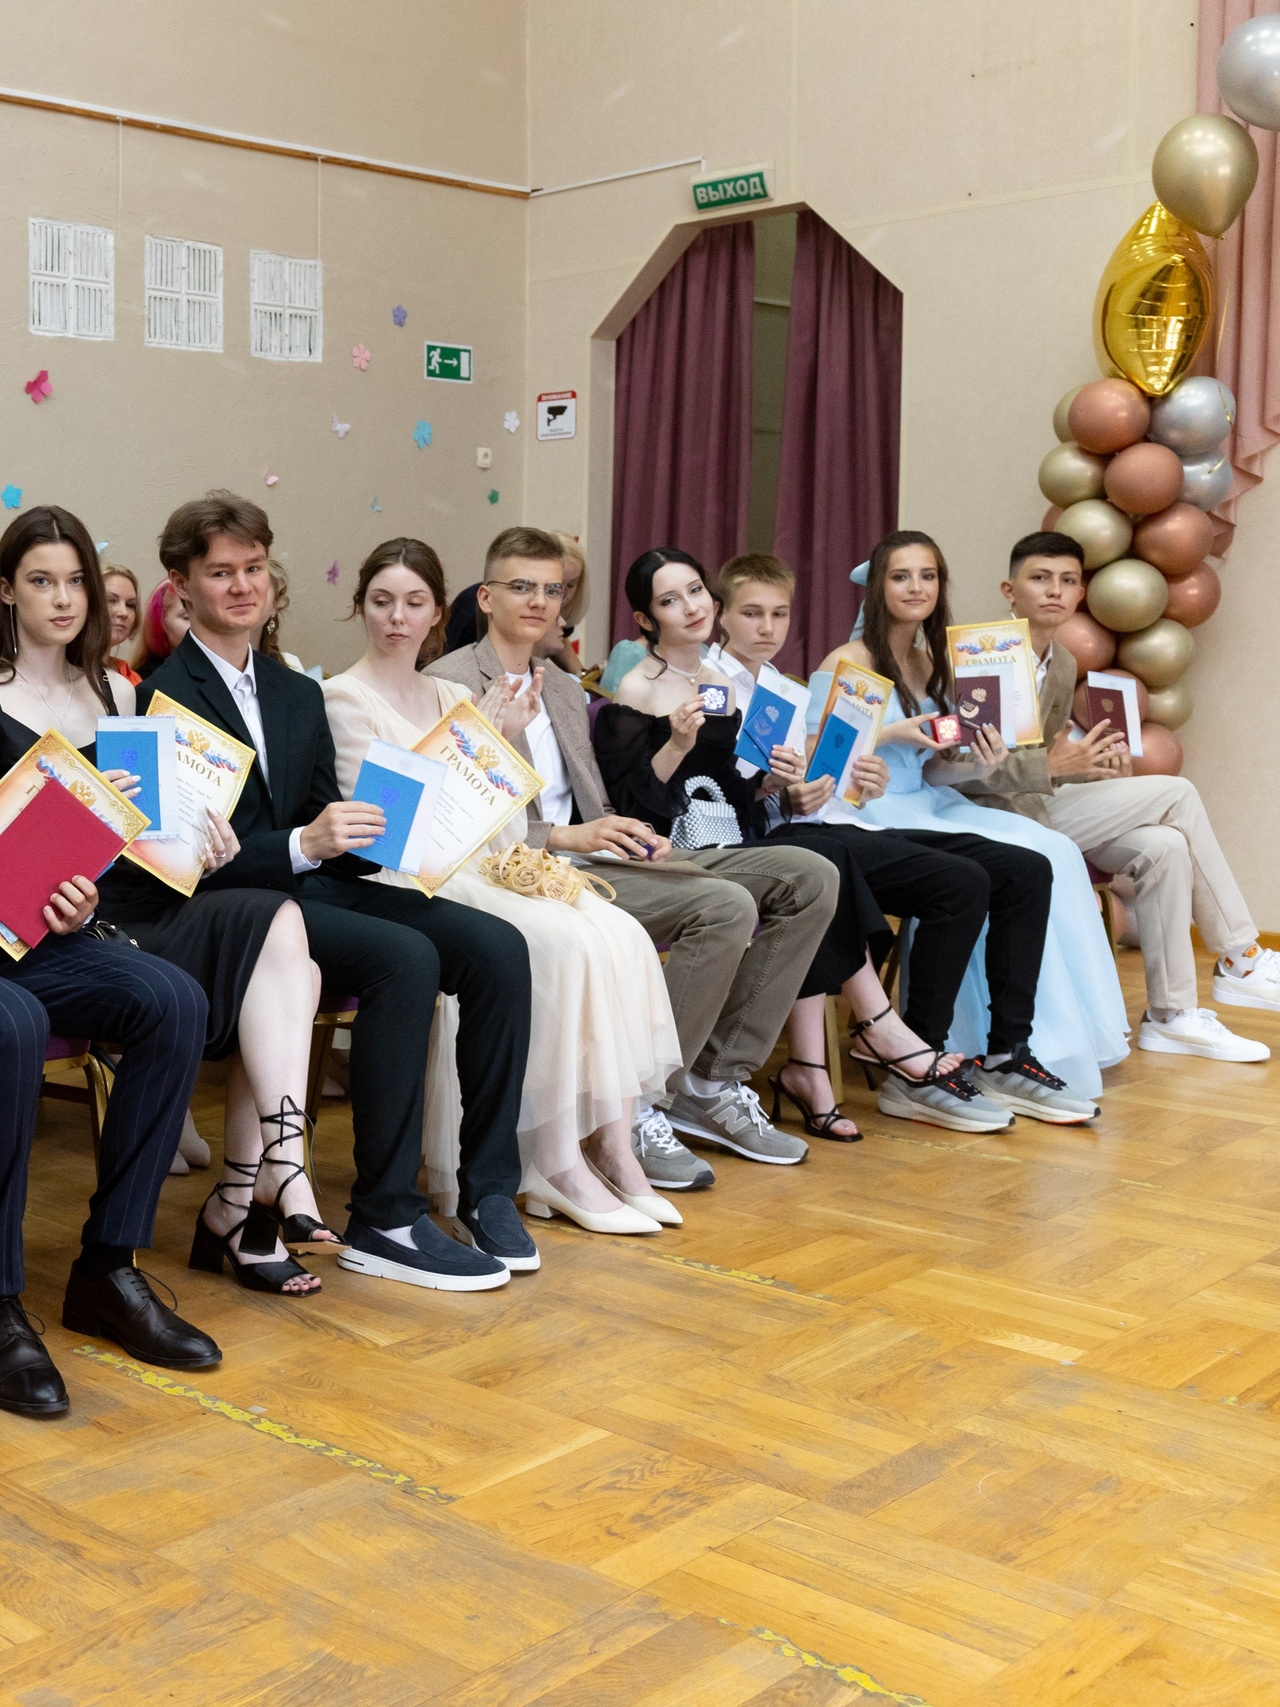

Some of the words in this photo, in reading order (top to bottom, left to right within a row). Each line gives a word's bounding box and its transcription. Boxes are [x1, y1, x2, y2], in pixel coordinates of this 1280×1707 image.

[695, 176, 764, 204] ВЫХОД
[965, 655, 1017, 666] ГРАМОТА
[176, 750, 221, 787] АМОТА
[439, 745, 496, 806] ГРАМОТА
